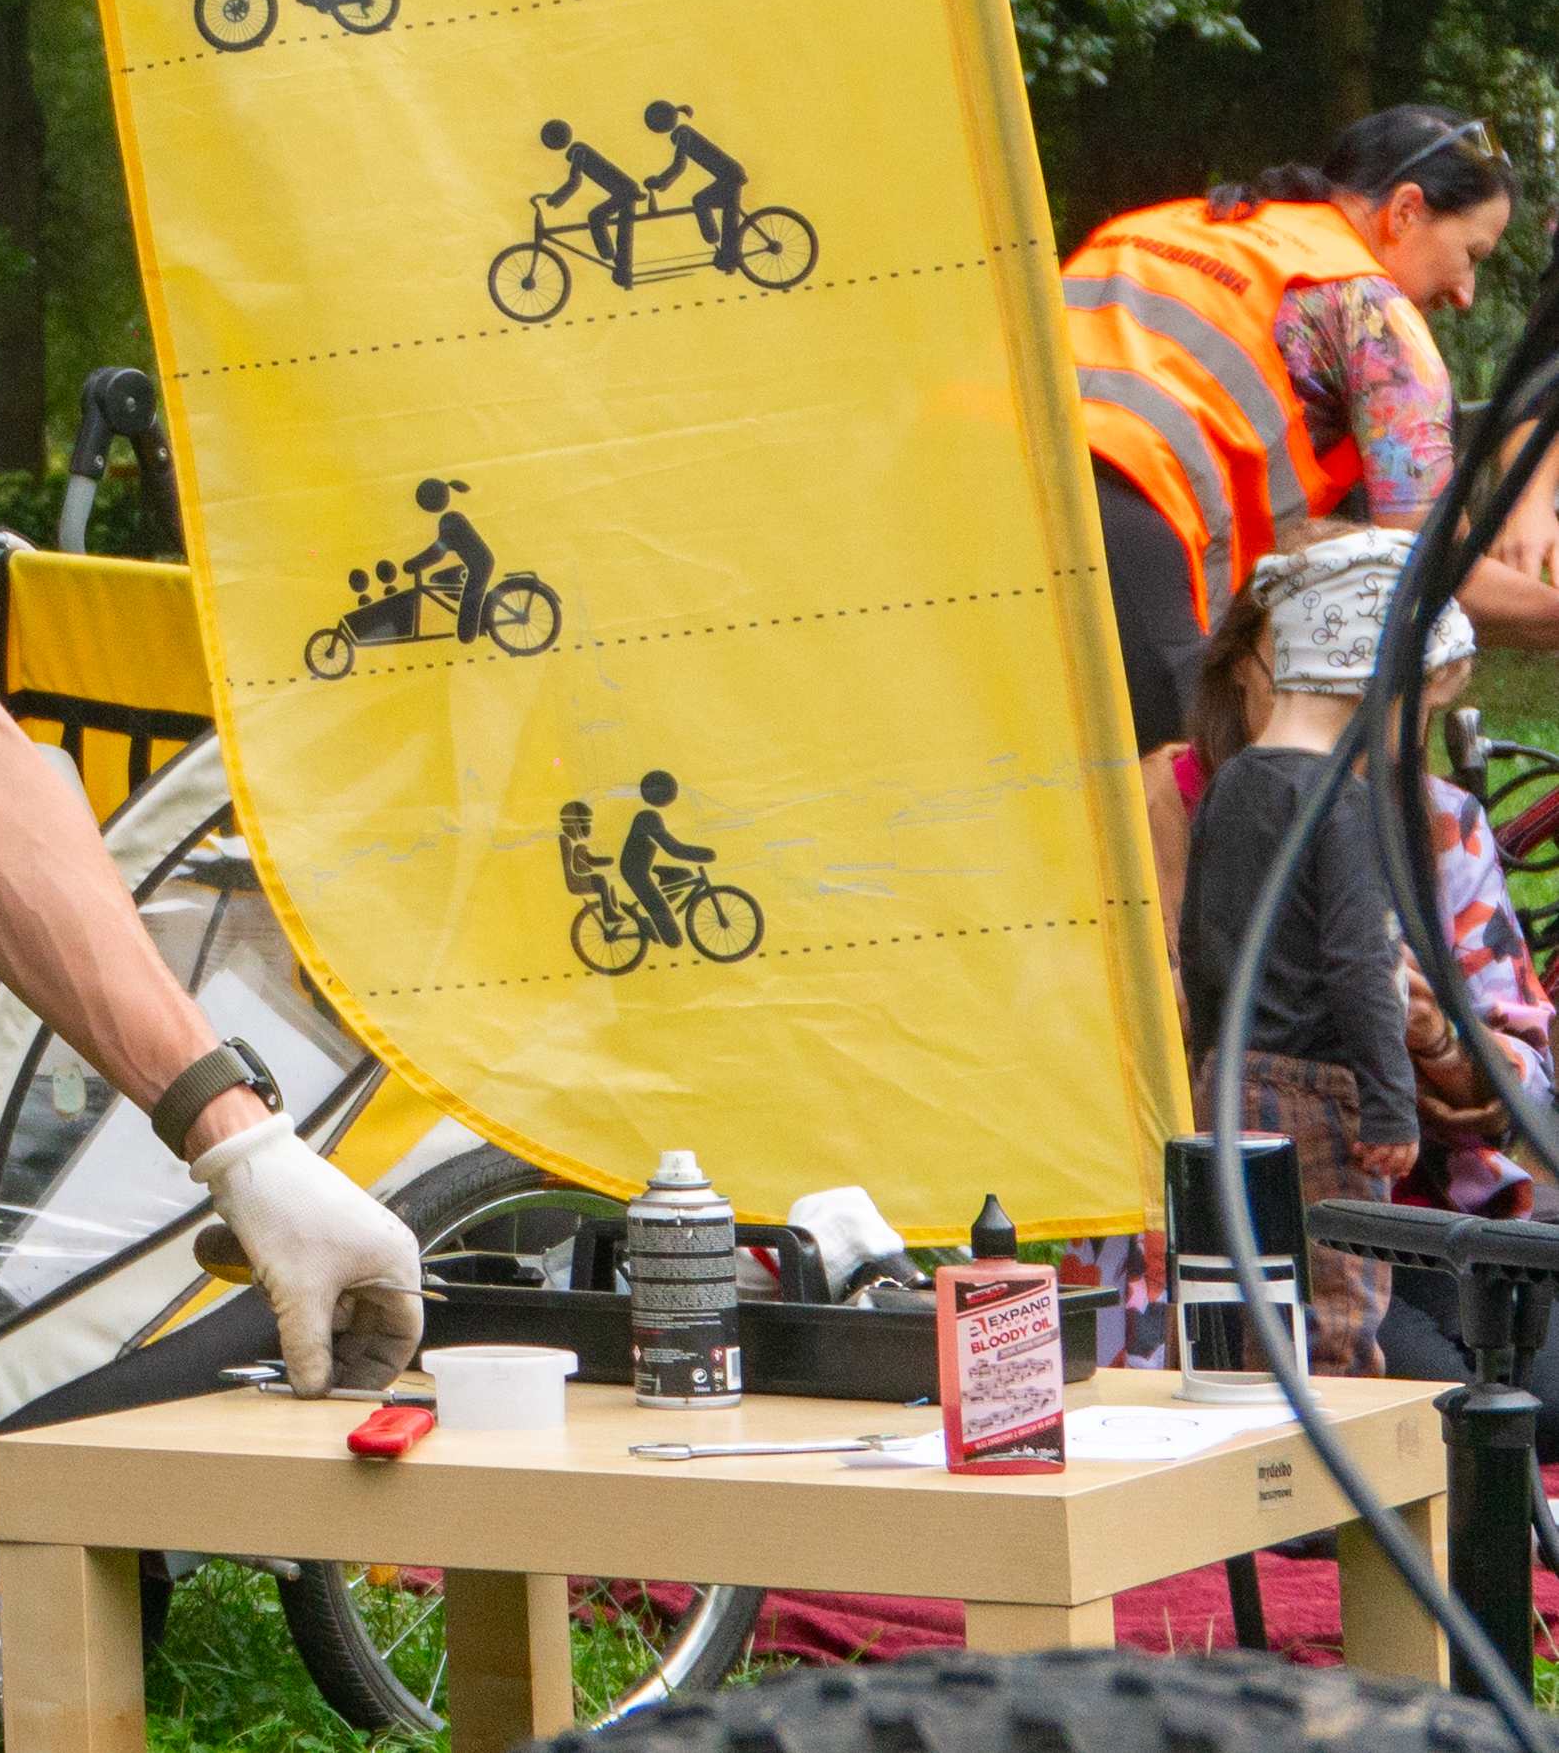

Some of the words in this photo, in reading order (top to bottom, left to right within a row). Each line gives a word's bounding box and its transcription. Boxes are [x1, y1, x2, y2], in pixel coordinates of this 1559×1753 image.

[987, 1295, 1052, 1328] EXPAND
[970, 1324, 1029, 1355] BLOODY
[1031, 1316, 1054, 1334] OIL
